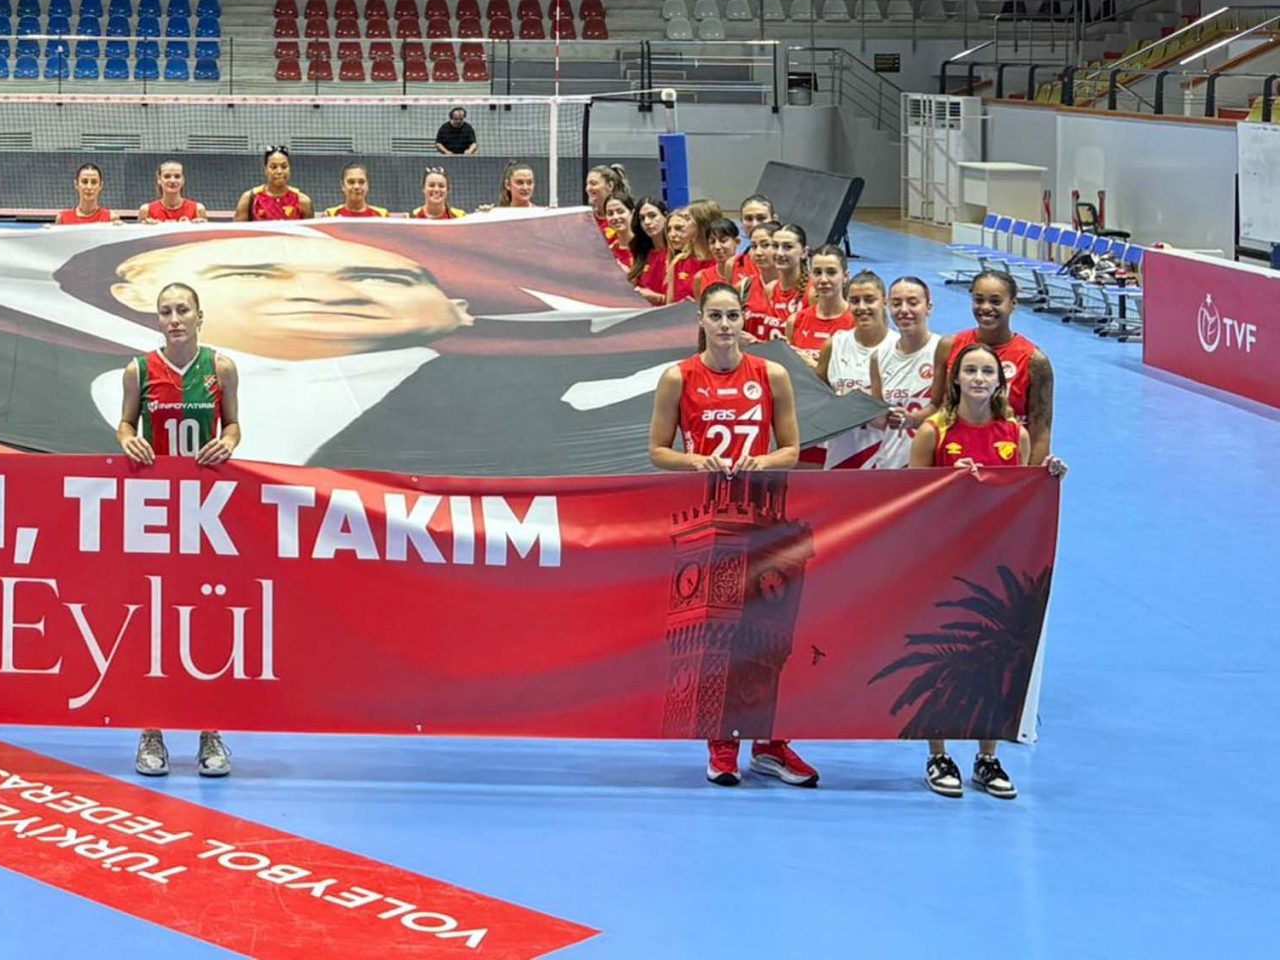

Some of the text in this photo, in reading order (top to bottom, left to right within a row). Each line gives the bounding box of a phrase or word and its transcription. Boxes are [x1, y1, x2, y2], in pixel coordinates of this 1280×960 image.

[1222, 317, 1257, 353] TVF
[702, 409, 736, 421] aras
[164, 418, 200, 457] 10
[706, 424, 760, 467] 27
[63, 476, 239, 556] TEK
[260, 485, 562, 567] TAKIM
[197, 839, 489, 949] VOLEYBOL
